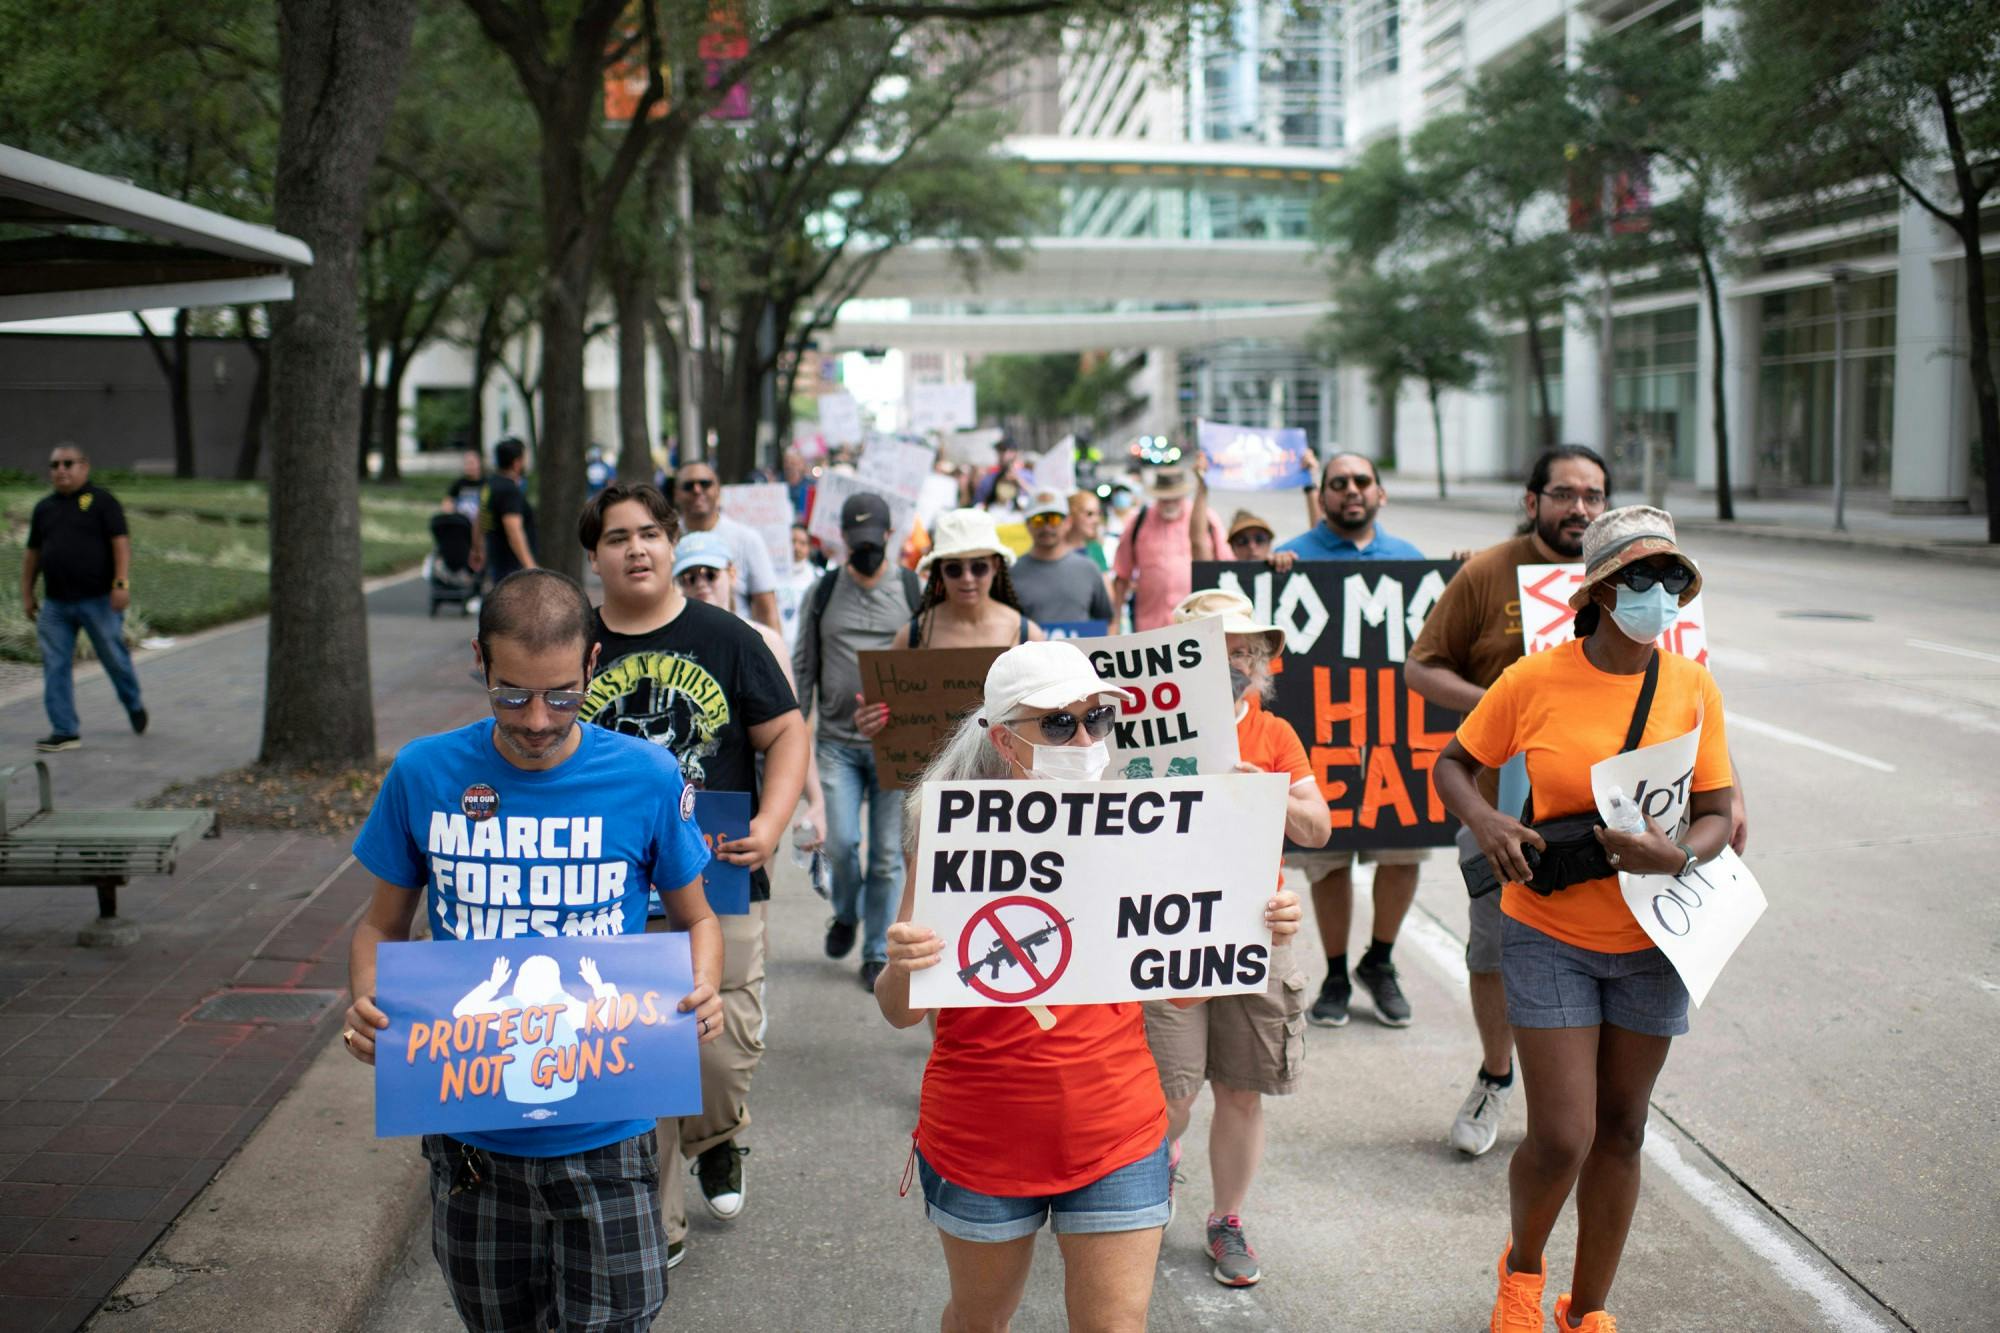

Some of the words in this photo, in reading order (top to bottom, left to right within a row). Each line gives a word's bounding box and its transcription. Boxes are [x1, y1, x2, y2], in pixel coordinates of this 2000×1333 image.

[1218, 570, 1330, 654] NO
[875, 662, 927, 696] How
[1088, 638, 1203, 679] GUNS
[577, 672, 621, 722] UNS
[667, 659, 727, 720] ROSES
[1120, 682, 1181, 716] DO
[1268, 656, 1458, 751] HIL
[1114, 712, 1198, 749] KILL
[428, 811, 603, 859] MARCH
[937, 789, 1204, 836] PROTECT
[431, 855, 522, 906] FOR
[529, 861, 628, 906] OUR
[932, 849, 1065, 894] KIDS
[436, 895, 559, 940] LIVES
[1116, 890, 1222, 938] NOT
[1129, 943, 1268, 990] GUNS
[406, 1003, 567, 1064] PROTECT
[584, 991, 668, 1036] KIDS.
[439, 1054, 515, 1103] NOT
[531, 1036, 635, 1089] GUNS.
